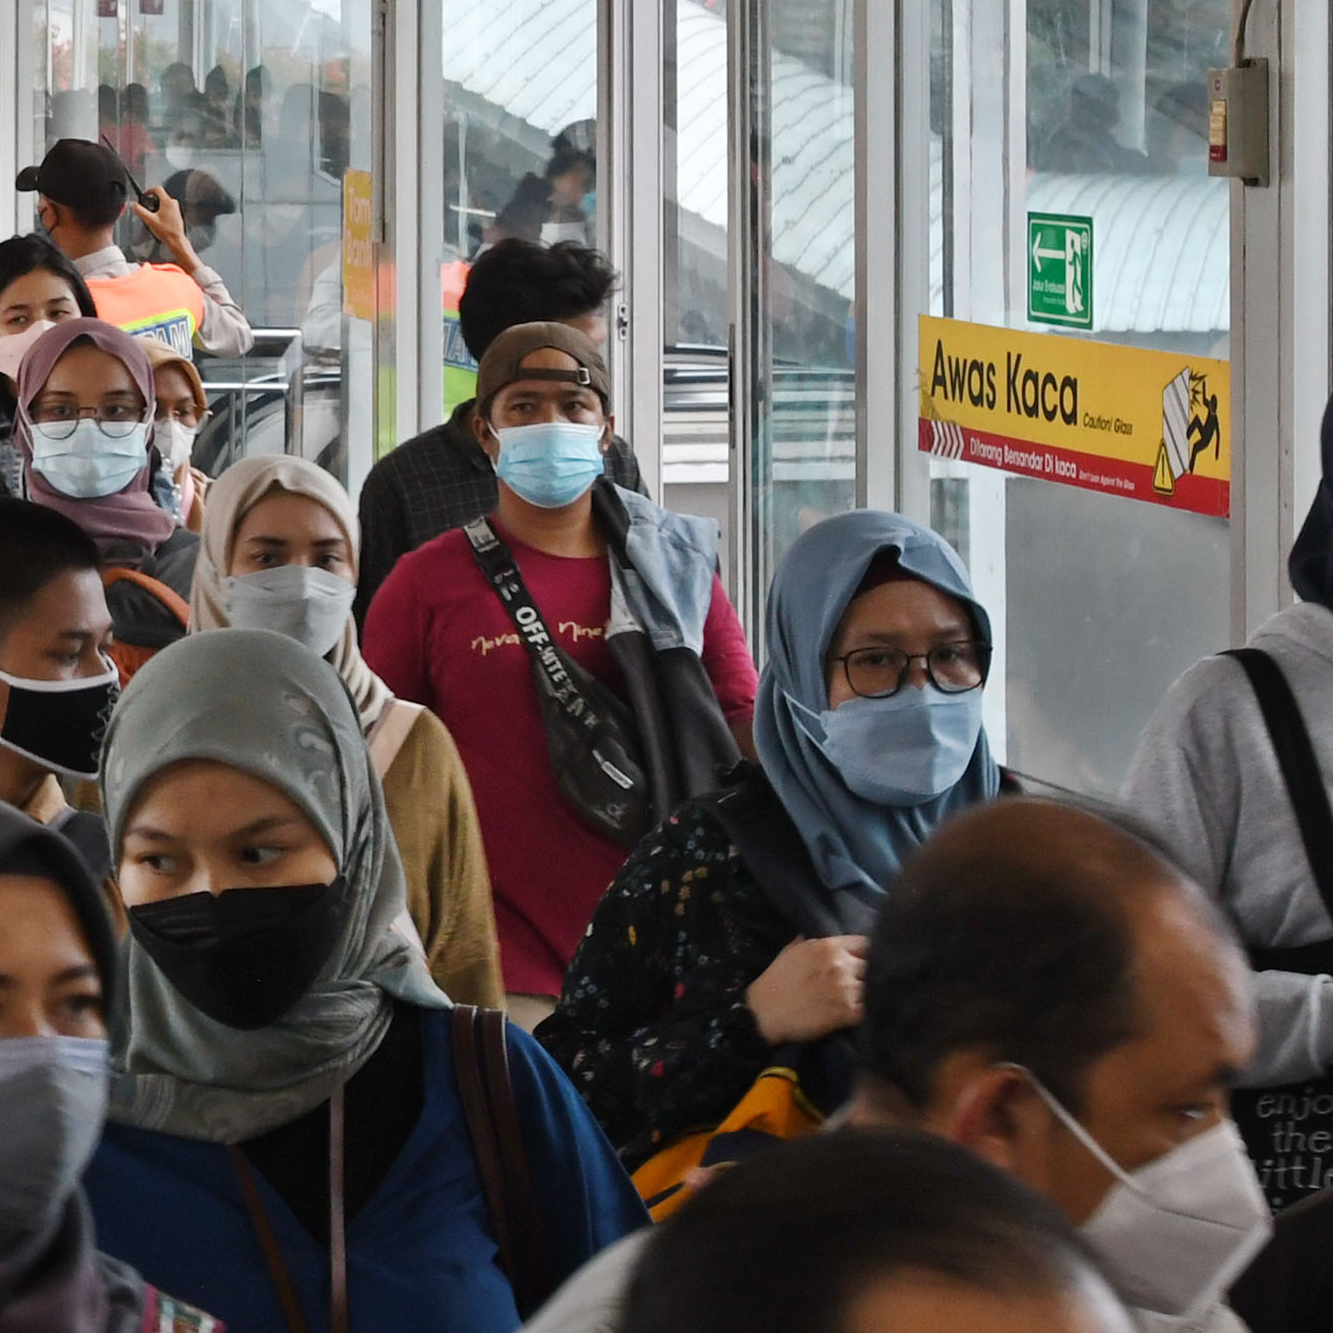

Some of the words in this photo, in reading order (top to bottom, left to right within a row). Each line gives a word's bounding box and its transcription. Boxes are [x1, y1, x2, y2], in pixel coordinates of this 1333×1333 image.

[930, 338, 997, 411] Awas
[1006, 351, 1079, 426] Kaca
[1113, 417, 1134, 436] Glass
[970, 437, 1003, 466] Dilarang
[1003, 445, 1044, 470] Bersandar
[1045, 452, 1054, 474] Di
[1055, 455, 1077, 479] kaca
[1270, 1120, 1333, 1154] the
[1259, 1154, 1333, 1190] ittl
